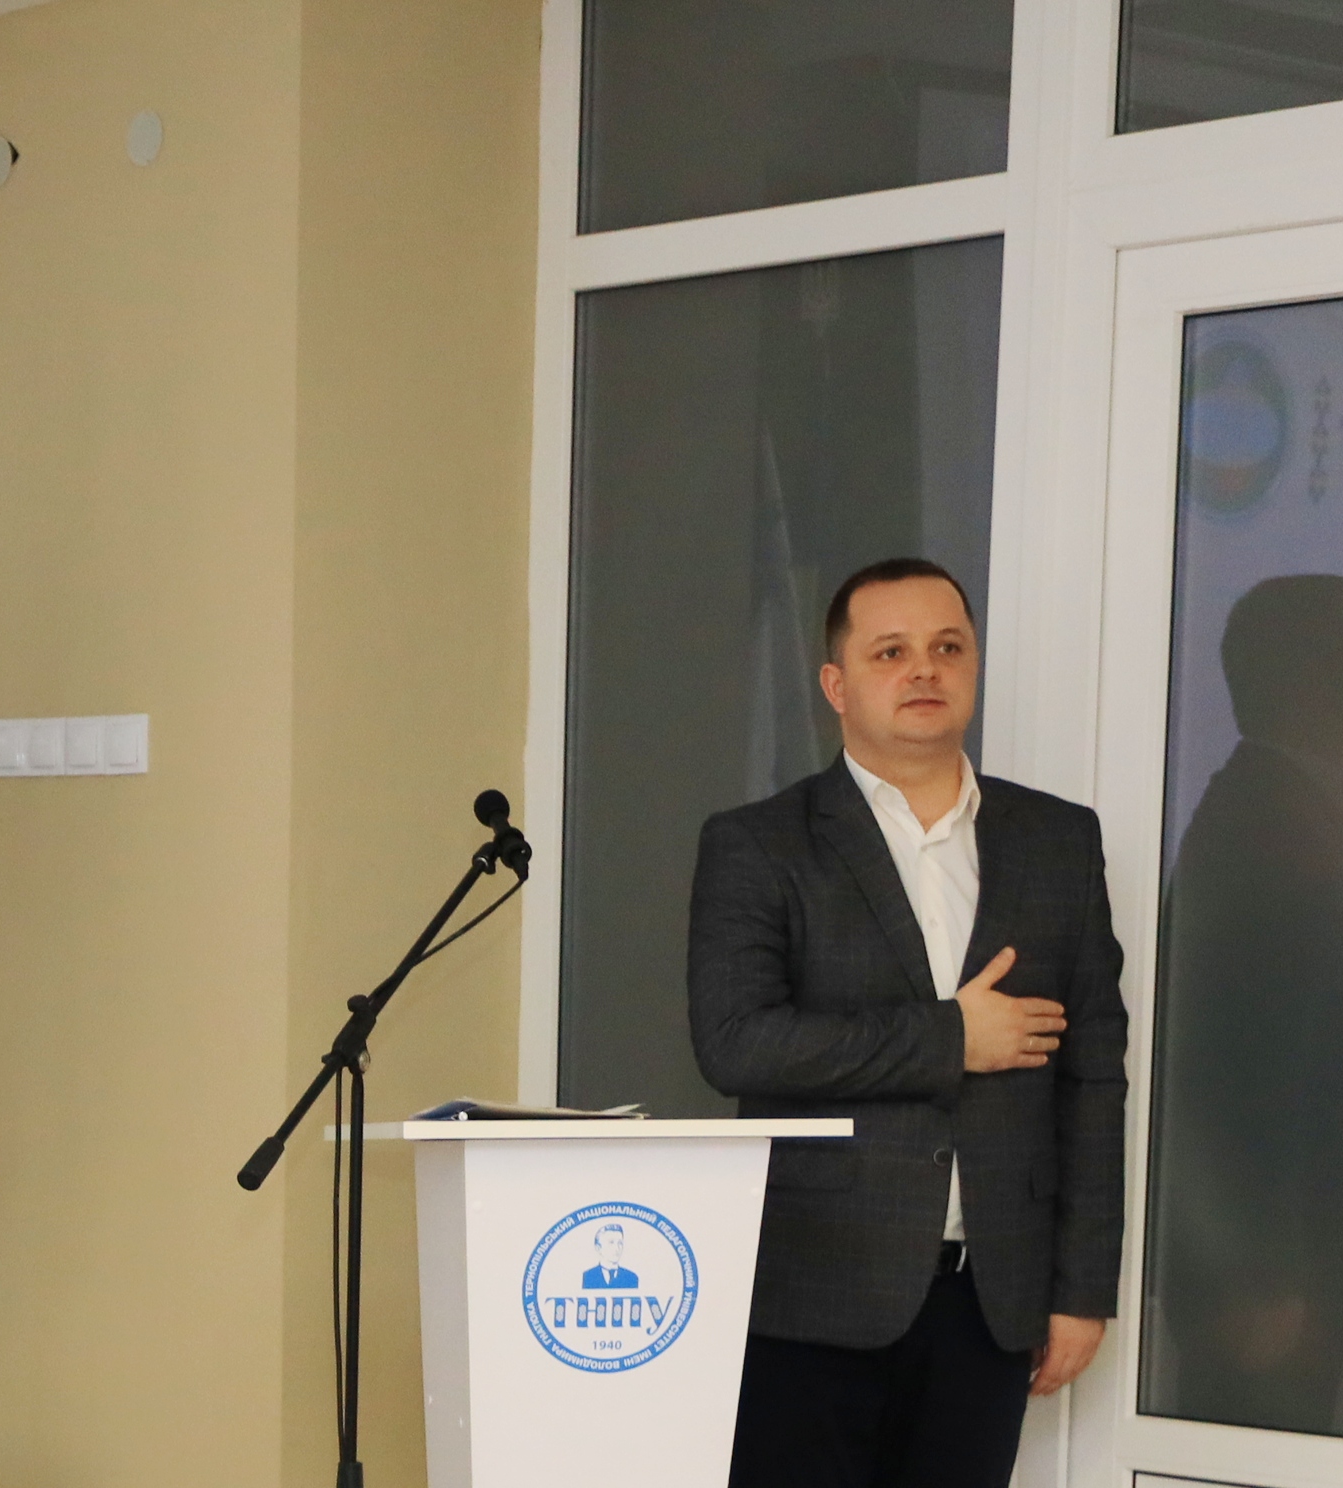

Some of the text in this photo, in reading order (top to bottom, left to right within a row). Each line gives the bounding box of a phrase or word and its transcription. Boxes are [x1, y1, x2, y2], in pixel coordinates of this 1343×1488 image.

[525, 1205, 696, 1371] ТЕРНОПІЛЬСЬКИЙ НАЦІОНАЛЬНИЙ ПЕДАГОГІЧНИЙ УНІВЕРСИТЕТ ІМЕНІ ВОЛОДИМИРА ГНАТЮКА
[545, 1296, 674, 1336] ТНПУ
[592, 1340, 623, 1351] 1940
